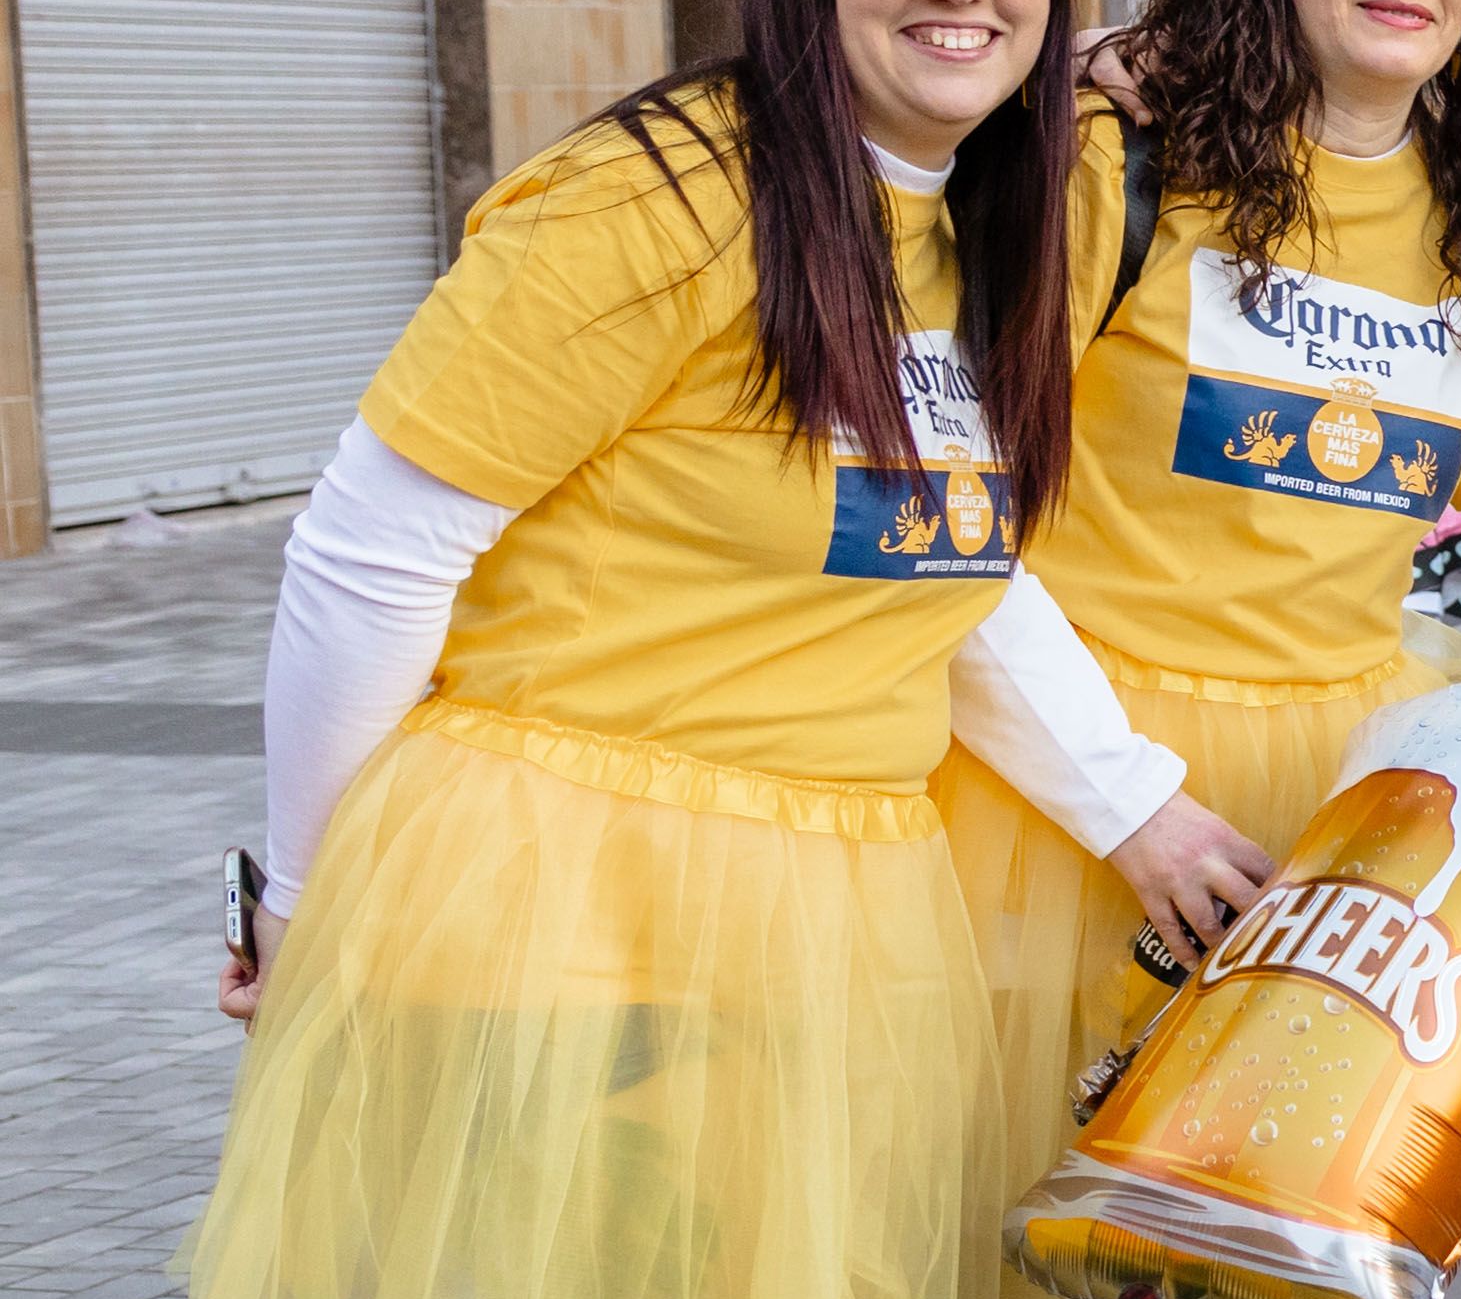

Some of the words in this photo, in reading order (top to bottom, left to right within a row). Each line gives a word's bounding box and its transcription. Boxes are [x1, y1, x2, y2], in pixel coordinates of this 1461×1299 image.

[1239, 277, 1448, 357] Corona
[1304, 339, 1393, 378] Extra
[1338, 411, 1358, 427] LA
[1312, 419, 1380, 446] CERVEZA
[1327, 436, 1362, 455] MAS
[1323, 451, 1359, 469] FINA
[960, 479, 974, 494] LA
[1264, 471, 1315, 493] IMPORTED
[1315, 481, 1342, 498] BEER
[1342, 486, 1372, 503] FROM
[1373, 492, 1411, 510] MEXICO
[946, 494, 991, 510] CERVEZA
[959, 509, 982, 524] MAS
[958, 524, 982, 540] FINA
